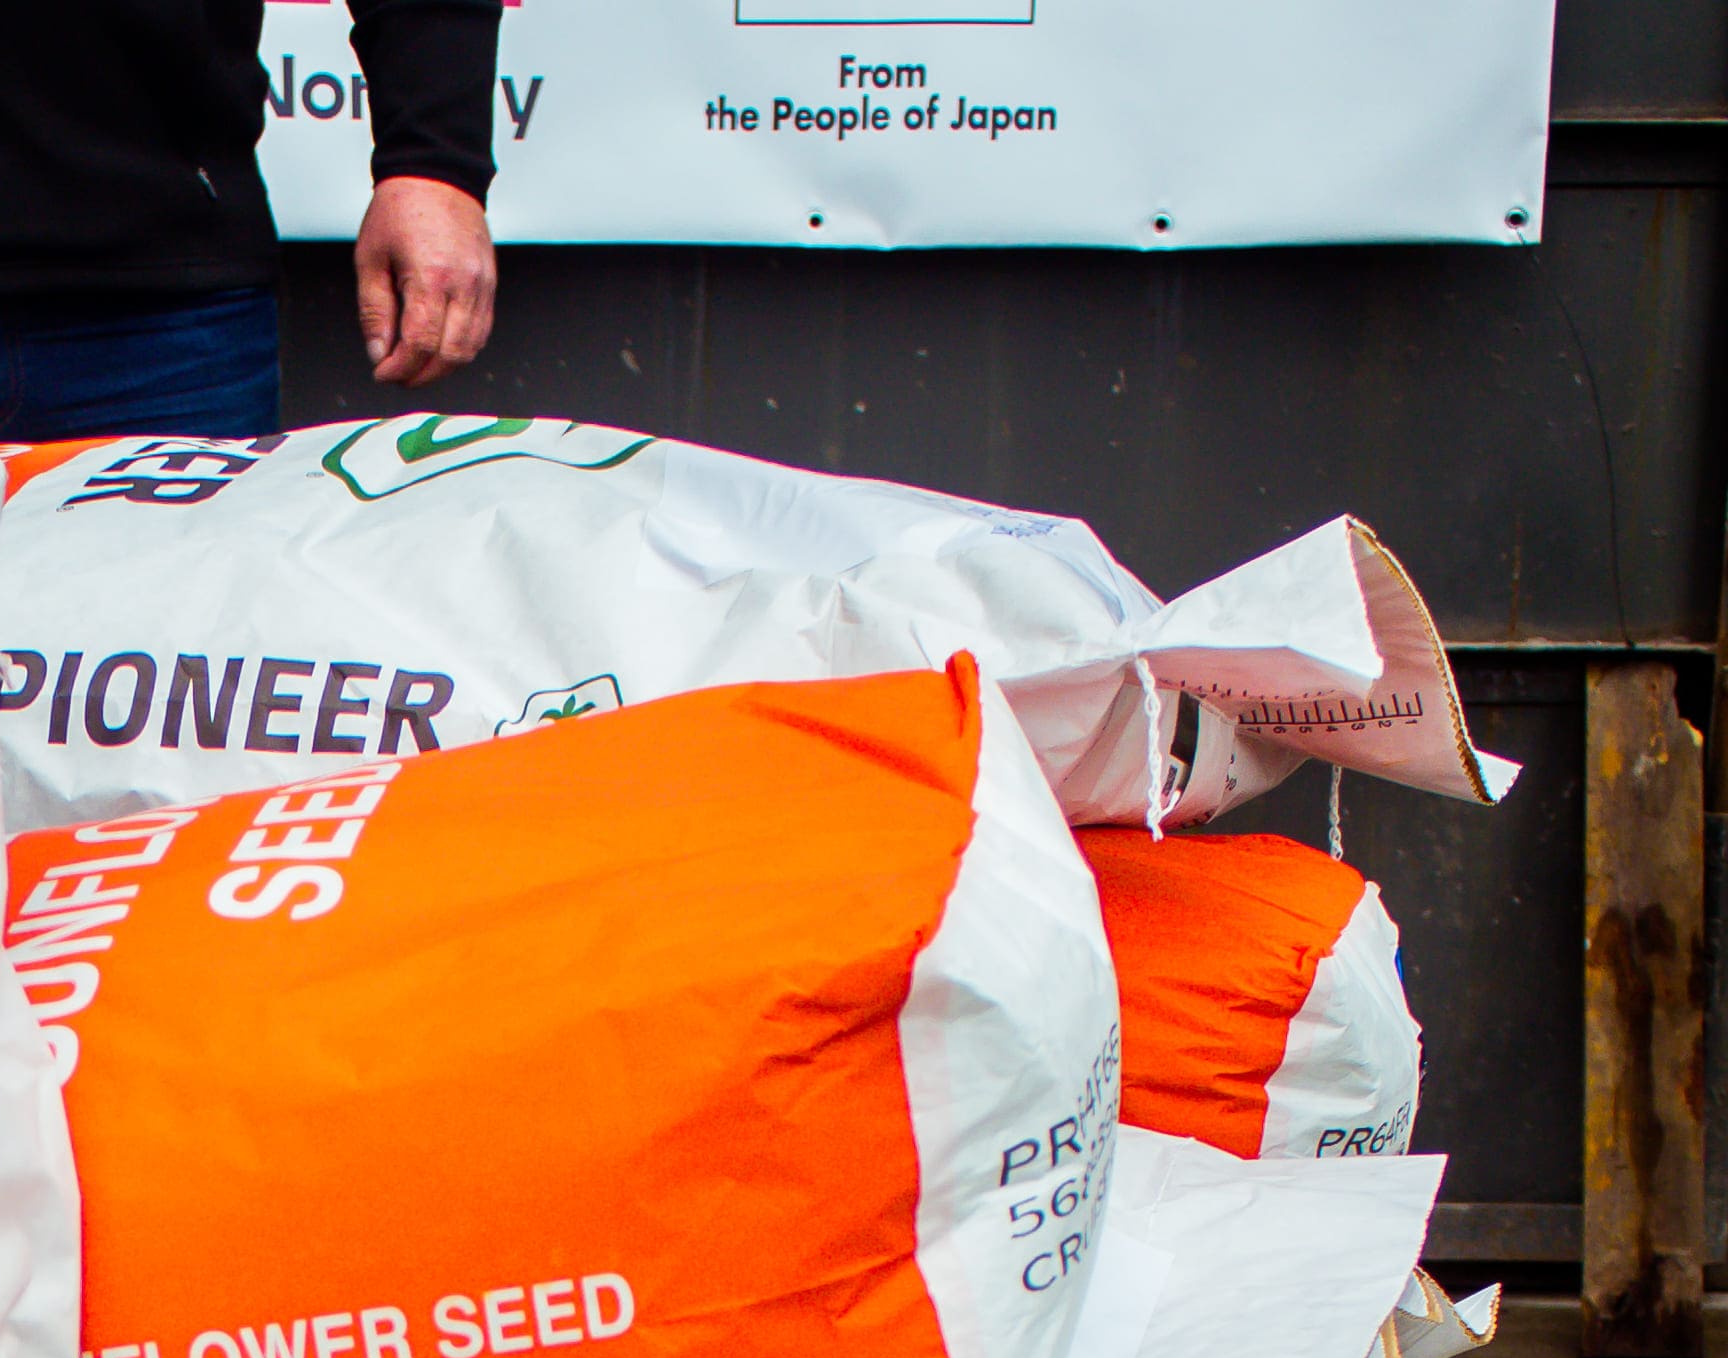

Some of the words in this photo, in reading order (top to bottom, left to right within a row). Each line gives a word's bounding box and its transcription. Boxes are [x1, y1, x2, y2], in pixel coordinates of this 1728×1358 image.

[839, 55, 927, 88] From
[266, 54, 544, 140] Nory
[706, 95, 760, 131] the
[773, 94, 890, 140] People
[904, 93, 940, 131] of
[951, 96, 1057, 140] Japan
